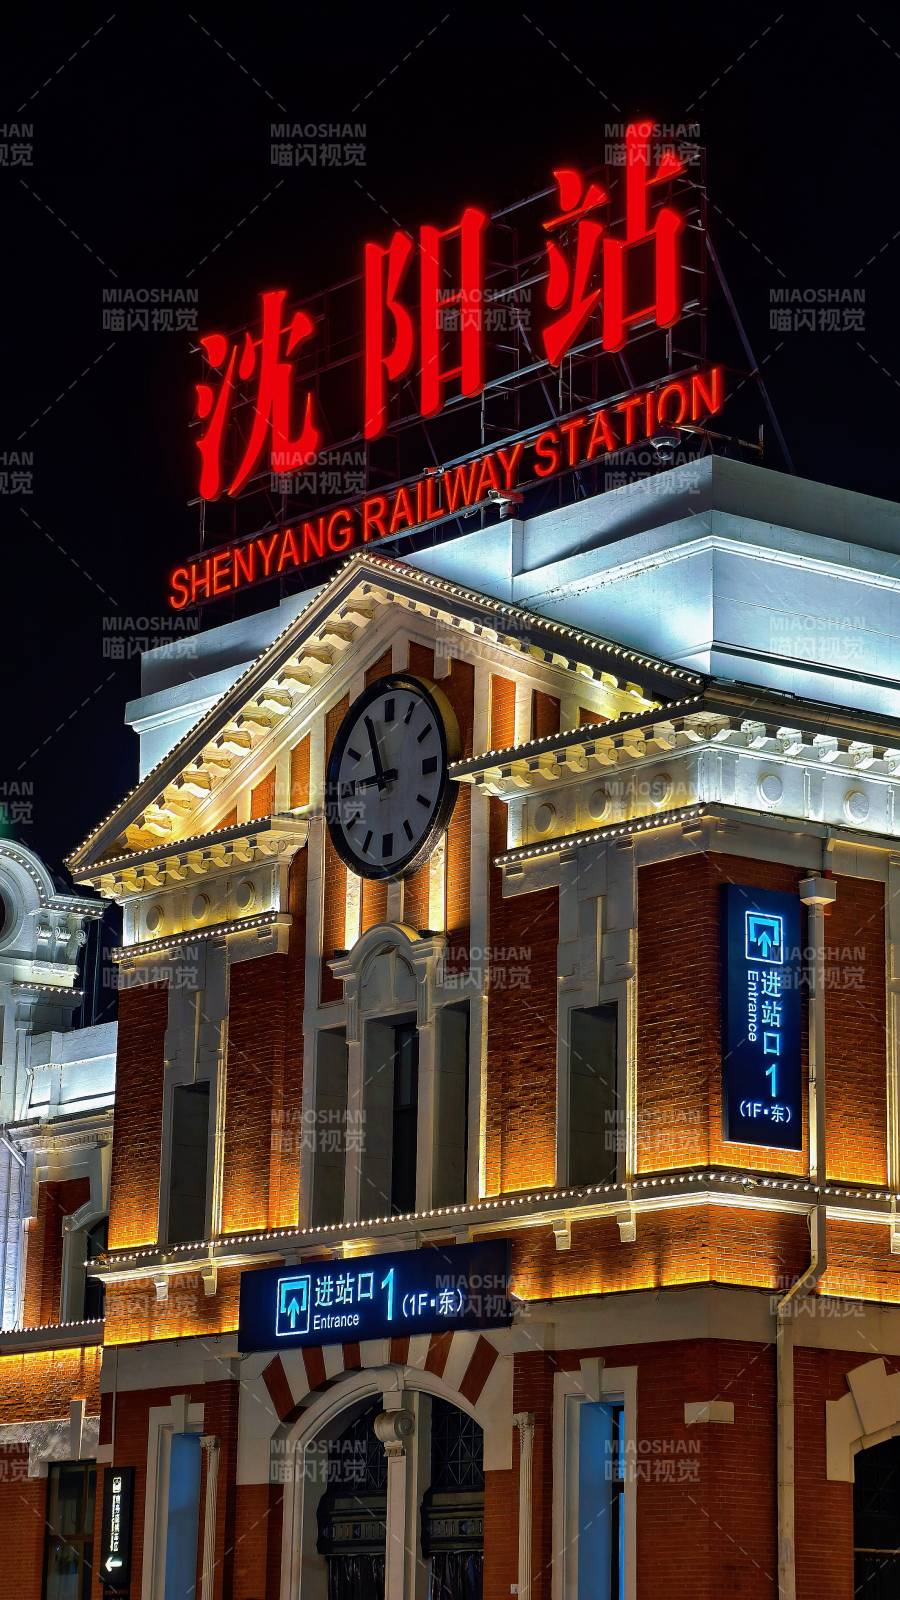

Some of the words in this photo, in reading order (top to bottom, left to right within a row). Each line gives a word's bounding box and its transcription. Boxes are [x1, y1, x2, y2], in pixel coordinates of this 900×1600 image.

[194, 120, 687, 501] 沈阳站
[169, 508, 354, 610] SHENYANG
[362, 442, 525, 542] RAILWAY
[533, 367, 722, 478] STATION
[747, 969, 758, 1042] Entrance
[760, 970, 782, 1056] 进站口
[765, 1063, 777, 1098] 1
[313, 1313, 360, 1330] Entrance
[314, 1271, 374, 1307] 进站口
[380, 1268, 394, 1321] 1
